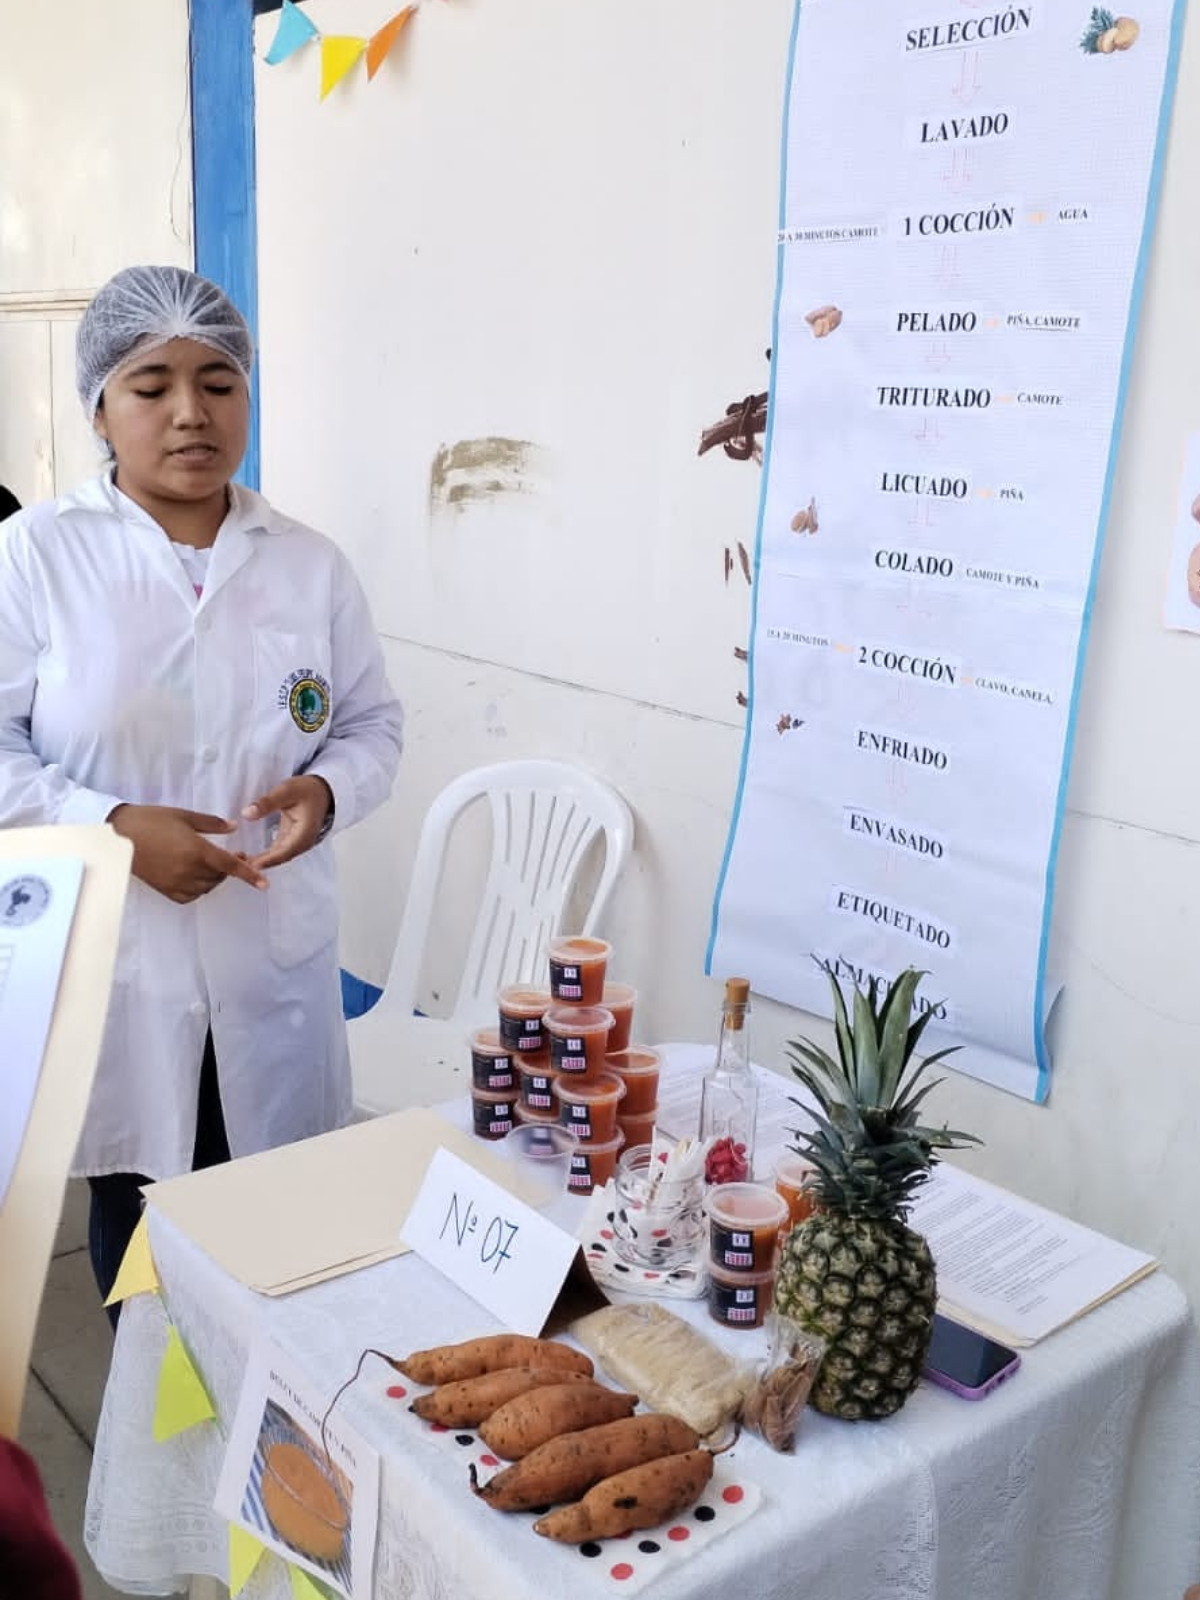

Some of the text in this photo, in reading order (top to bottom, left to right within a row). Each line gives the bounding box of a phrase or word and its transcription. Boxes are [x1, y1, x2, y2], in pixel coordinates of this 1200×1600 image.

[905, 5, 1032, 51] SELECCIÓN
[921, 113, 1008, 143] LAVADO
[904, 204, 1015, 236] 1 COCCIÓN
[1058, 209, 1088, 221] AGUA
[897, 311, 977, 332] PELADO
[1034, 315, 1080, 328] CAMOTE
[877, 387, 991, 409] TRITURADO
[1018, 393, 1063, 406] CAMOTE
[881, 473, 968, 499] LICUADO
[1000, 488, 1024, 501] PIÑA
[875, 550, 954, 577] COLADO
[966, 568, 1003, 582] CAMOTE
[1015, 575, 1039, 589] PIÑA
[858, 647, 957, 685] 2 COCCIÓN
[857, 731, 948, 770] ENFRIADO
[850, 813, 943, 859] ENVASADO
[837, 891, 950, 949] ETIQUETADO
[481, 1216, 519, 1275] 07
